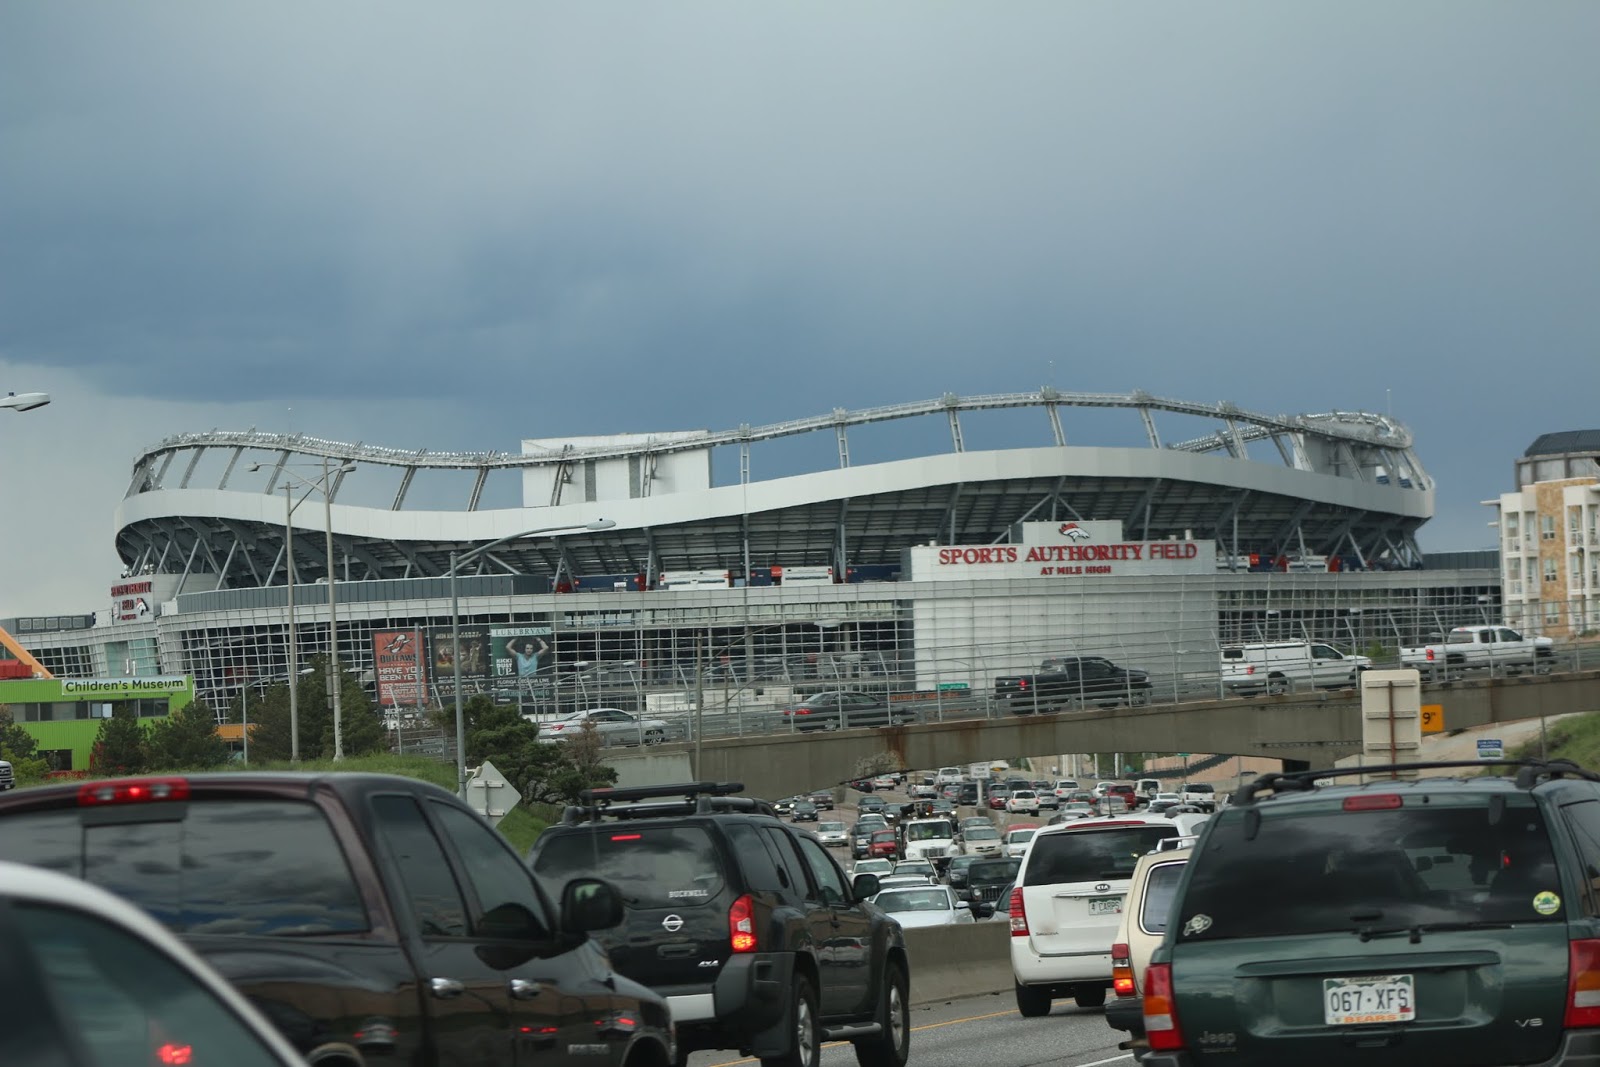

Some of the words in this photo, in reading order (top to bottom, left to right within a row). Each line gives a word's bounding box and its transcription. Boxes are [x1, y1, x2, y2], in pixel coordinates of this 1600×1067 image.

[939, 547, 1018, 565] SPORTS
[1025, 544, 1144, 562] AUTHORITY
[1150, 543, 1198, 559] FIELD
[1040, 567, 1054, 575] AT
[1057, 566, 1083, 574] MILE
[1085, 565, 1111, 574] HIGH
[65, 680, 129, 692] Children's
[132, 679, 184, 690] Museum
[438, 683, 486, 691] SATRDAY
[1343, 1014, 1397, 1024] BEARS
[1198, 1030, 1237, 1047] Jeep
